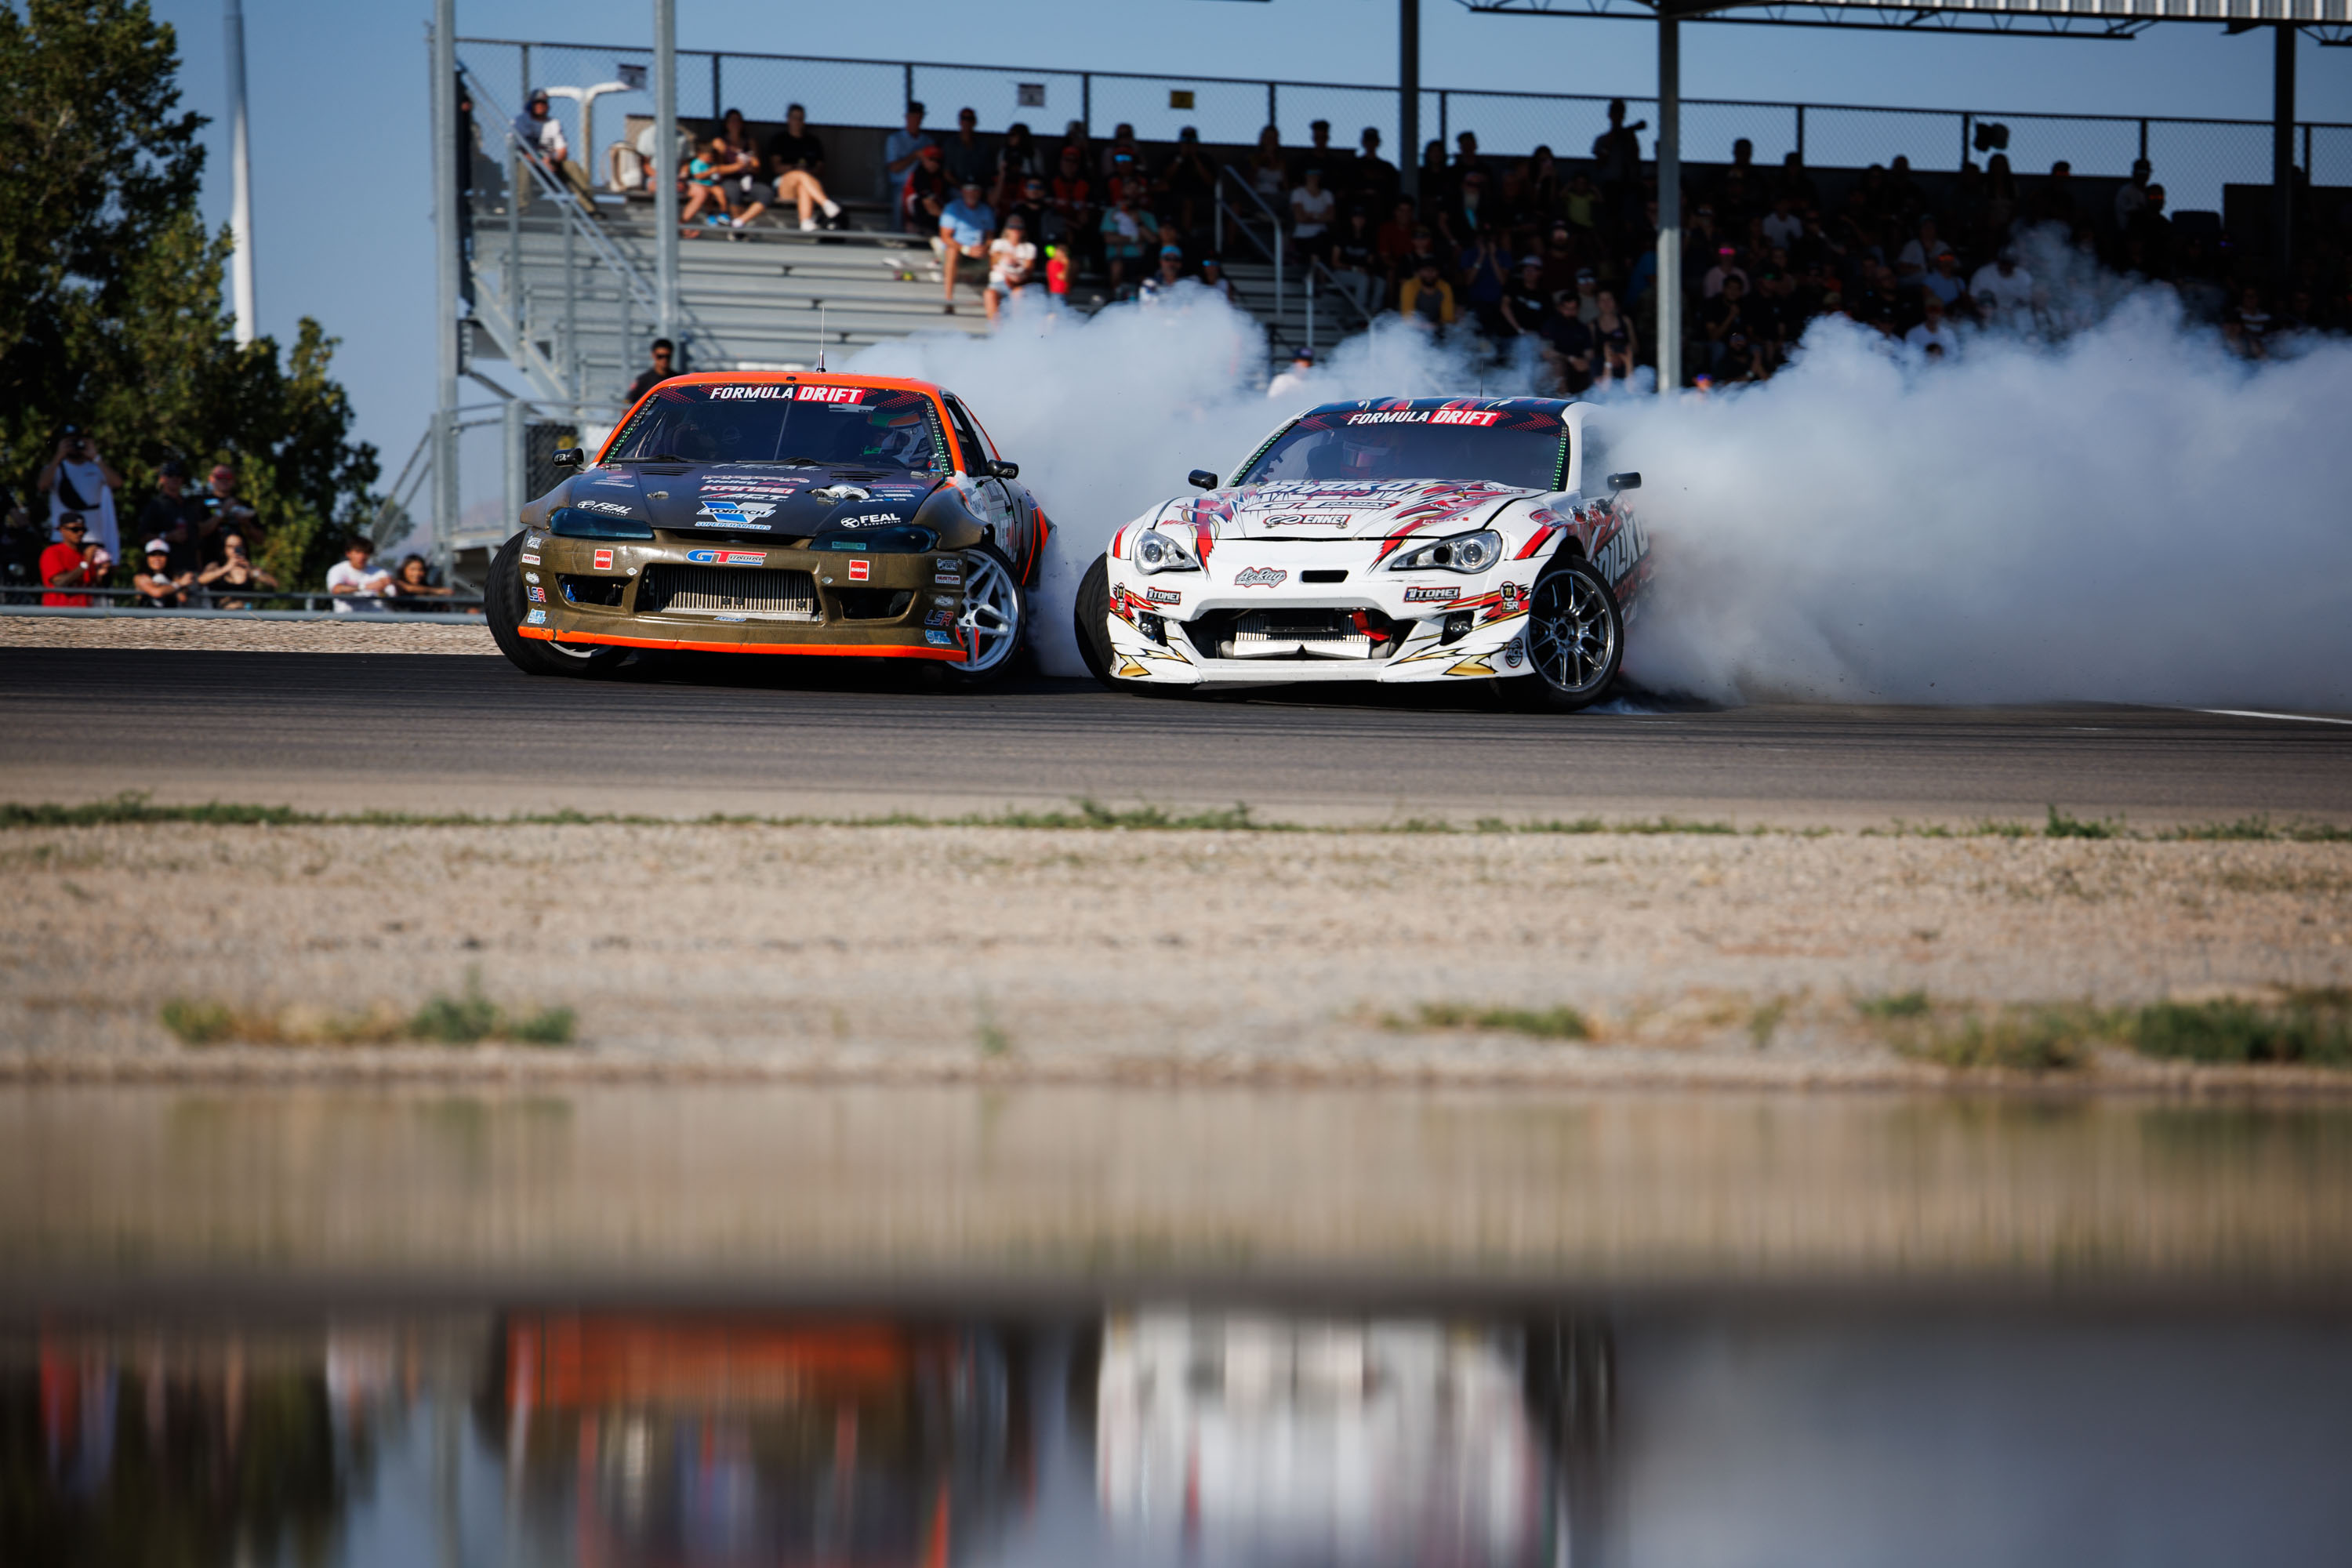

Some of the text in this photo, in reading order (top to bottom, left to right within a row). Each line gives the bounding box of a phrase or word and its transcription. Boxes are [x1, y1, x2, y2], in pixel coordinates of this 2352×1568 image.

[710, 387, 862, 402] FORMULA DRIFT
[1347, 411, 1497, 425] FORMULA DRIFT
[699, 485, 797, 495] KANSEI
[593, 502, 633, 514] FEAL
[860, 513, 901, 524] FEAL
[1302, 514, 1351, 524] ENKEI
[695, 521, 771, 530] SUPERCHARGERS
[686, 550, 757, 563] GT
[526, 586, 546, 603] LSR
[1153, 590, 1180, 601] TOMEI
[1417, 589, 1459, 598] TOMEI
[1502, 601, 1519, 610] ISR
[924, 609, 953, 626] LSR
[1507, 648, 1523, 658] ACL
